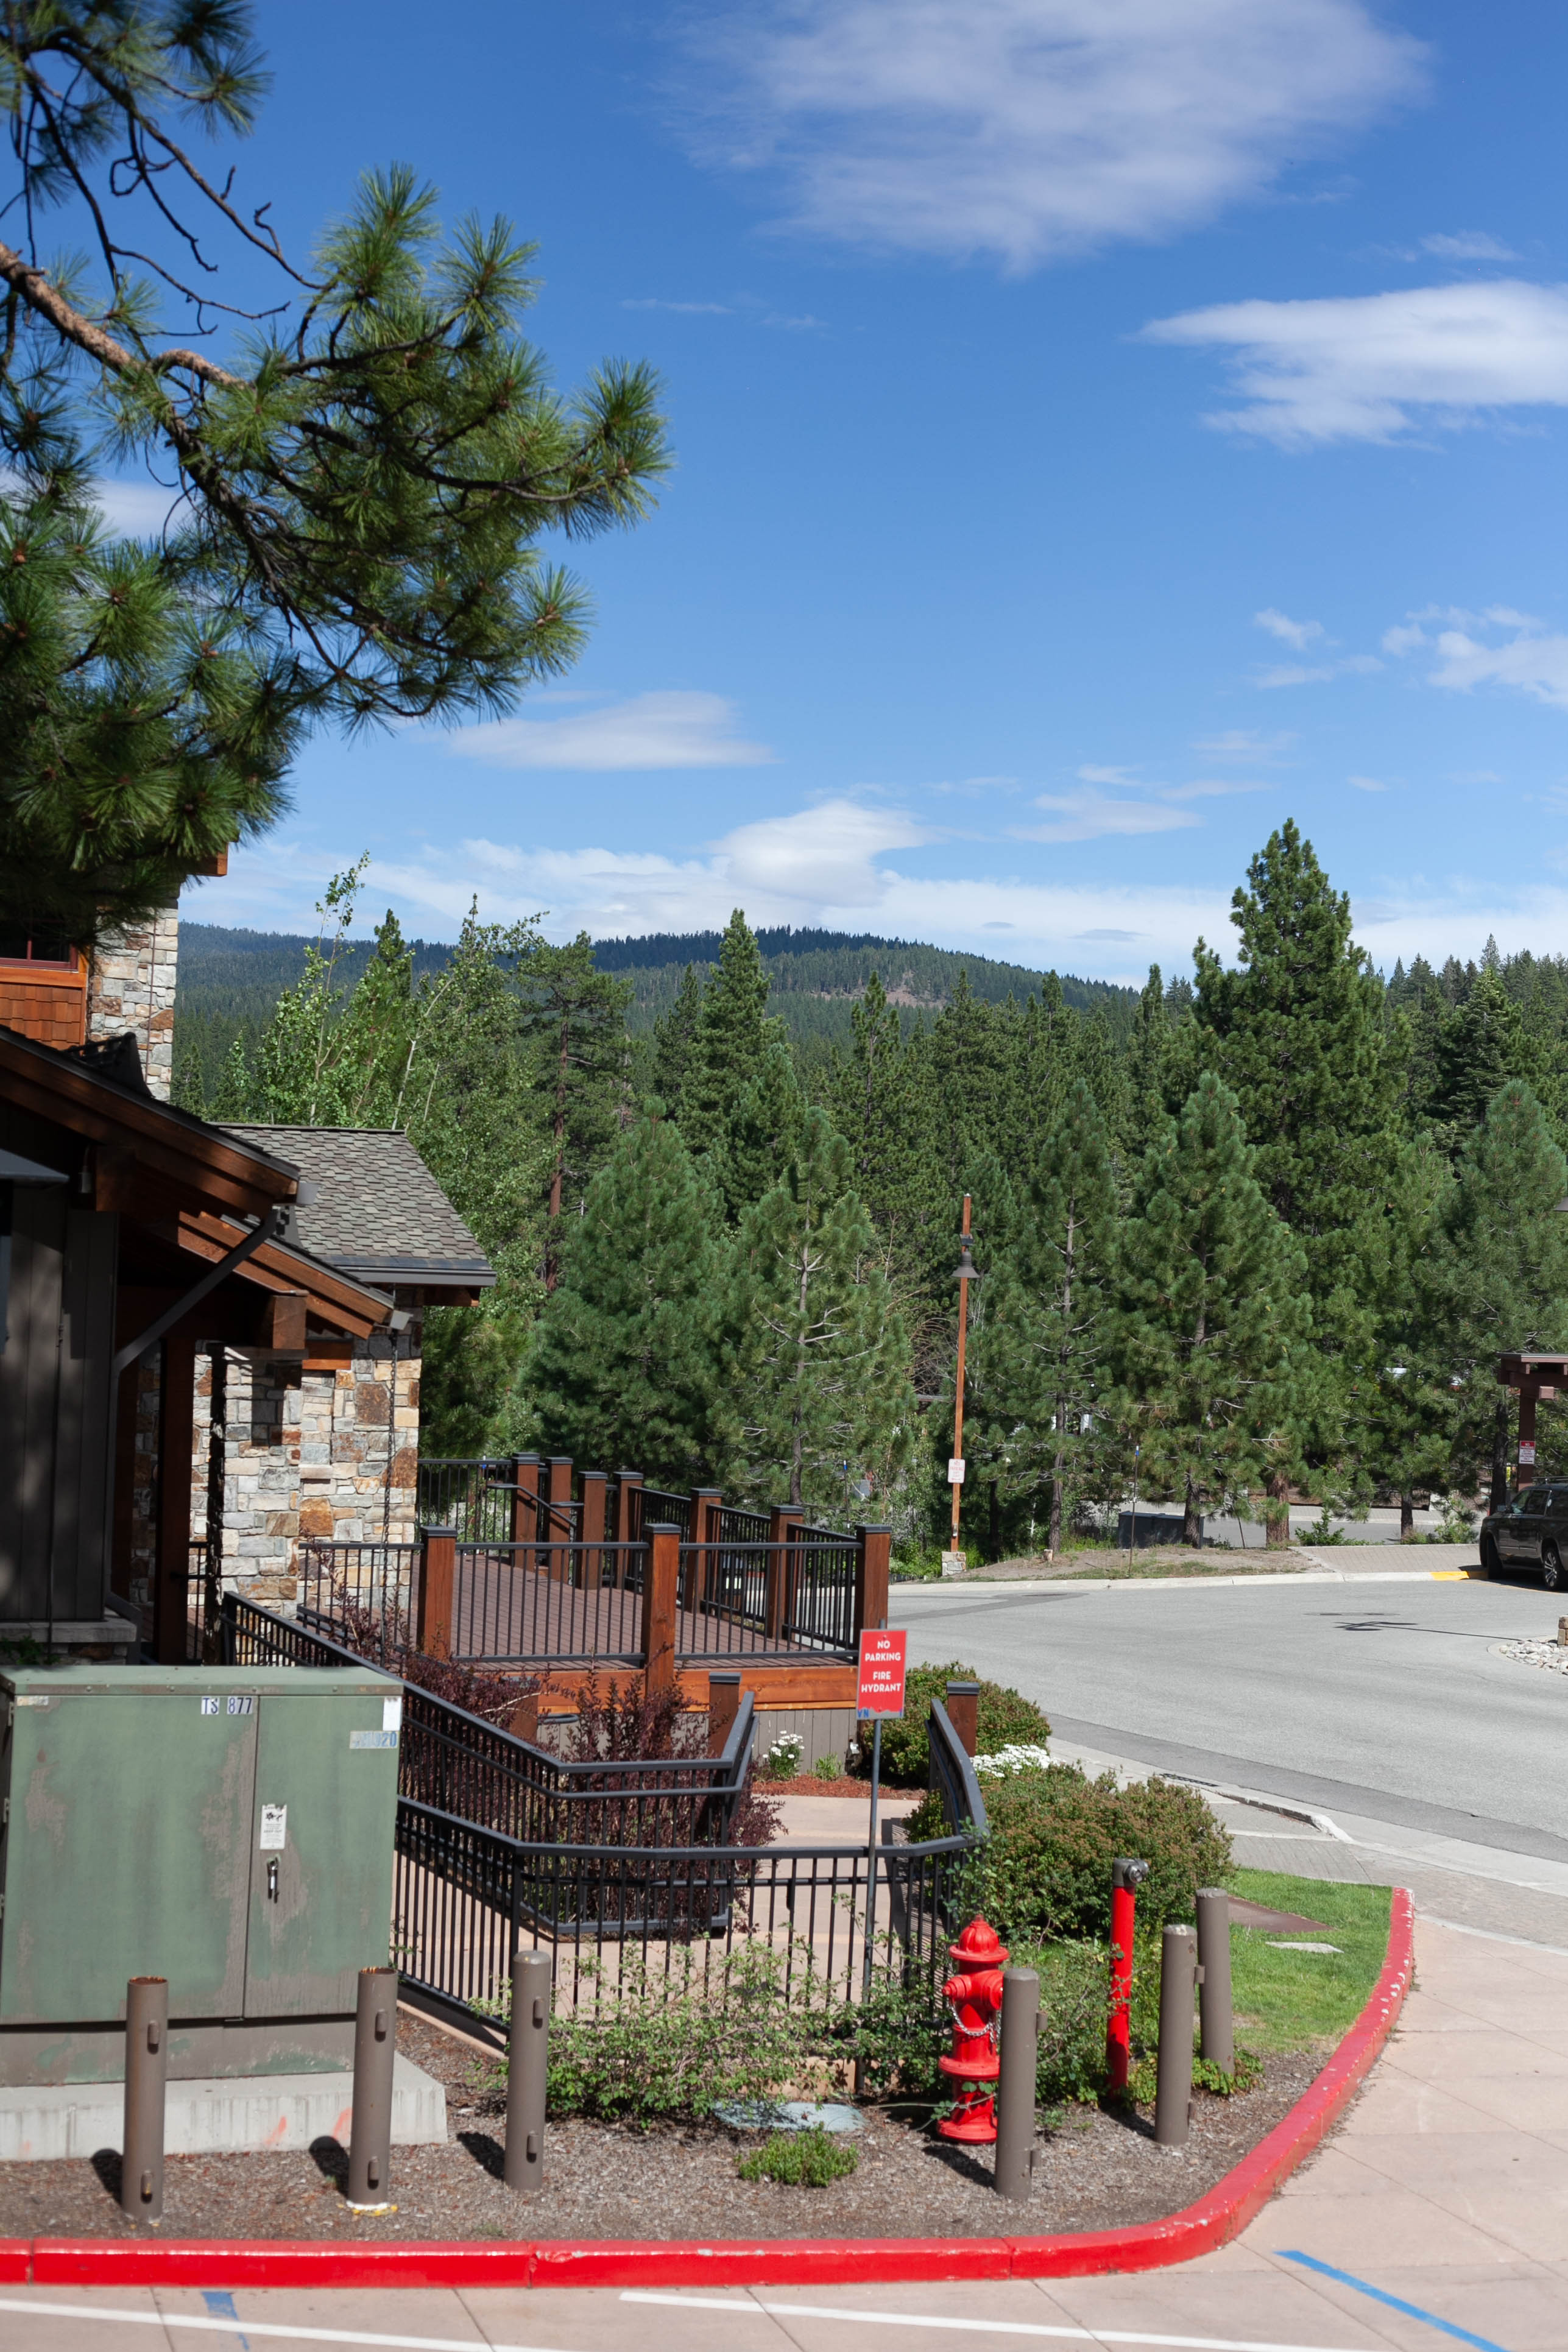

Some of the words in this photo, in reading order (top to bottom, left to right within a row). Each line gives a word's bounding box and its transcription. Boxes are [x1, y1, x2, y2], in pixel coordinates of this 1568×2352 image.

[877, 1640, 891, 1649] NO
[865, 1651, 901, 1662] PARKING
[873, 1671, 891, 1680] FIRE
[861, 1683, 902, 1693] HYDRANT
[202, 1697, 218, 1714] TS
[228, 1697, 252, 1714] 877
